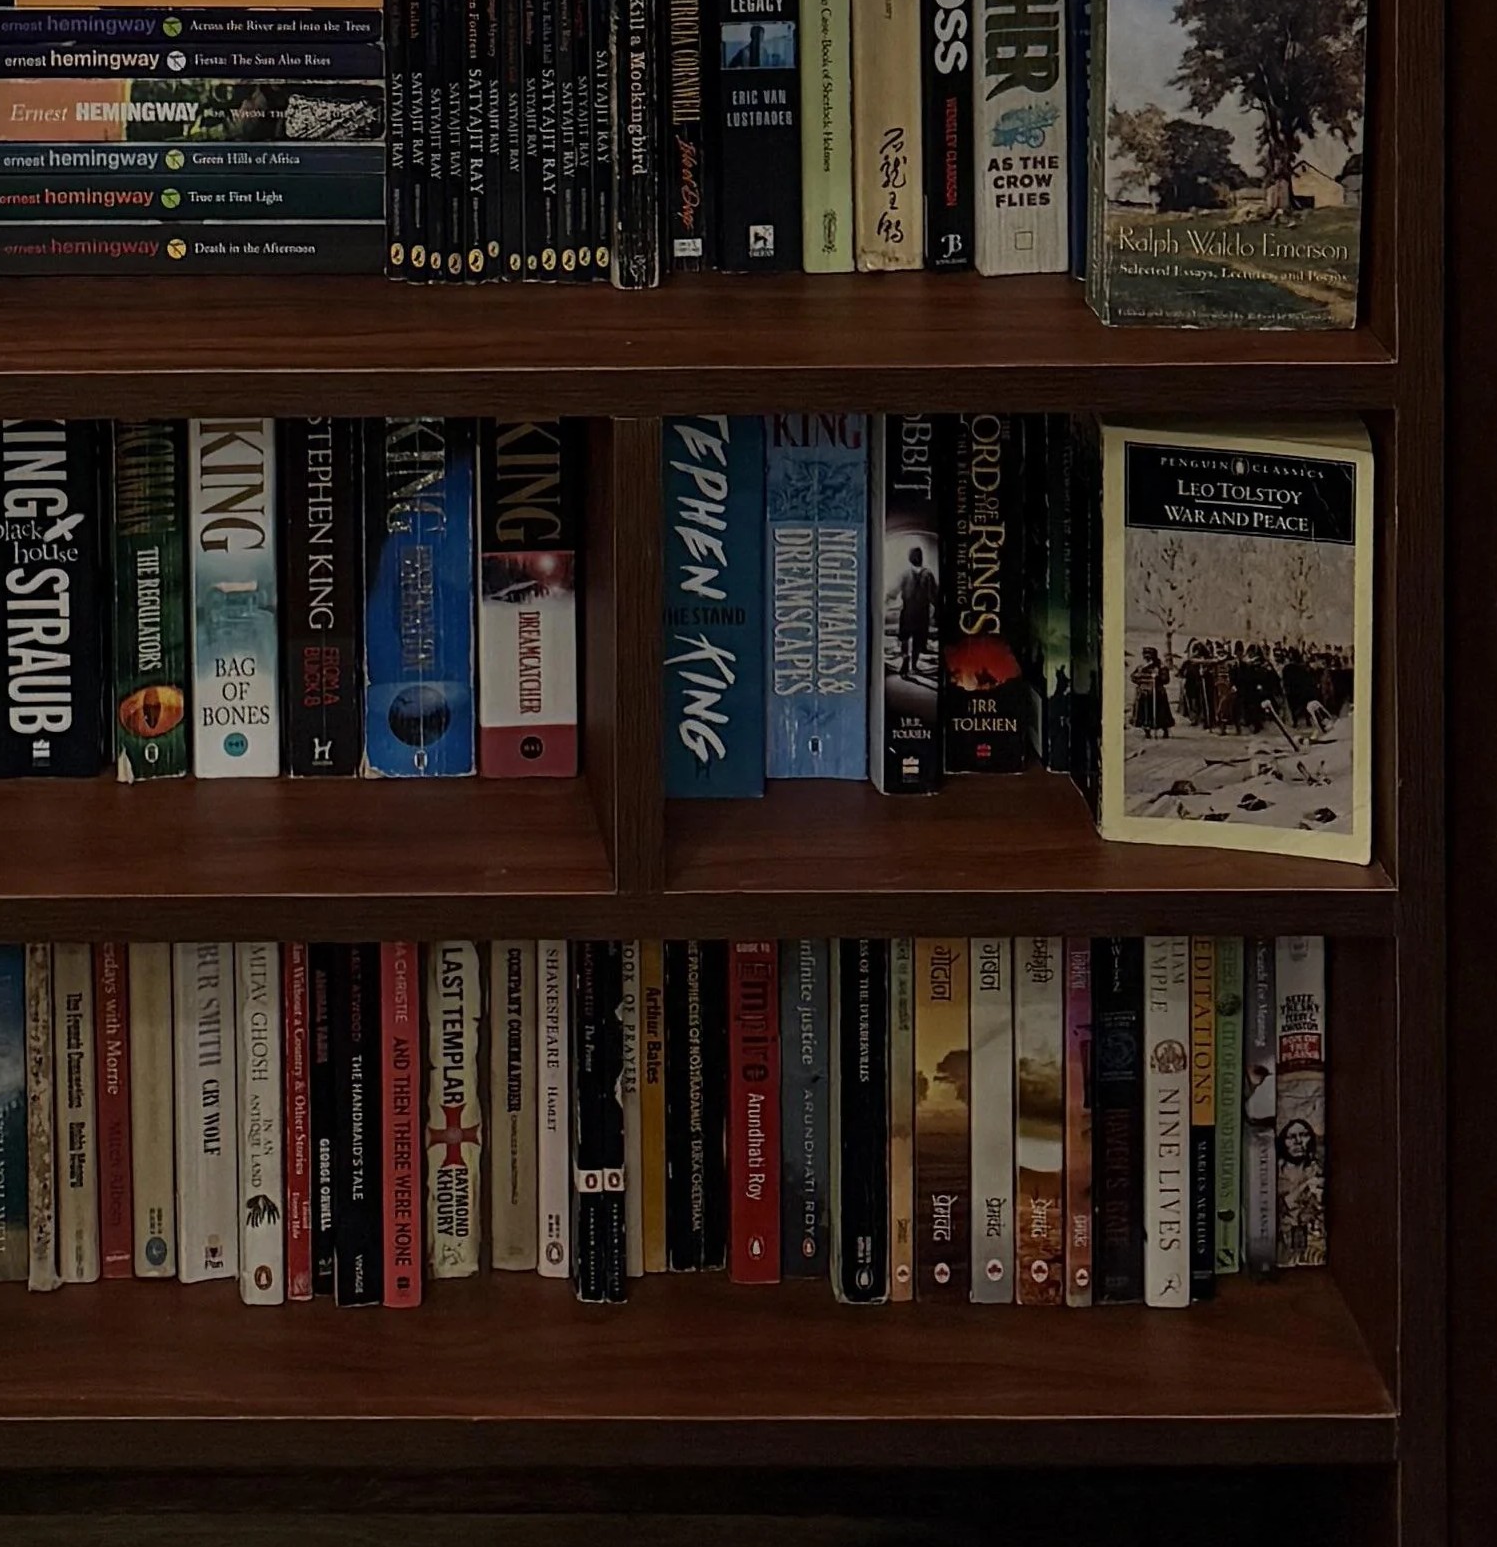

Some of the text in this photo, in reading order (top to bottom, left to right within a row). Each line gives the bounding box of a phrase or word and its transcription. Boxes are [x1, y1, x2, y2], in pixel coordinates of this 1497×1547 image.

[988, 156, 1059, 171] AS THE
[993, 174, 1052, 189] CROW
[996, 193, 1050, 208] FLIES
[1161, 457, 1325, 479] PENGUIN CLASSICS
[1177, 480, 1302, 505] LEO TOLSTOY
[1164, 505, 1308, 531] WAR AND PEACE
[14, 542, 79, 564] house
[215, 657, 255, 678] BAG
[222, 683, 250, 702] OF
[203, 707, 270, 726] BONES
[441, 948, 465, 1105] LAST TEMPLAR
[745, 1093, 765, 1202] Arundhati Roy
